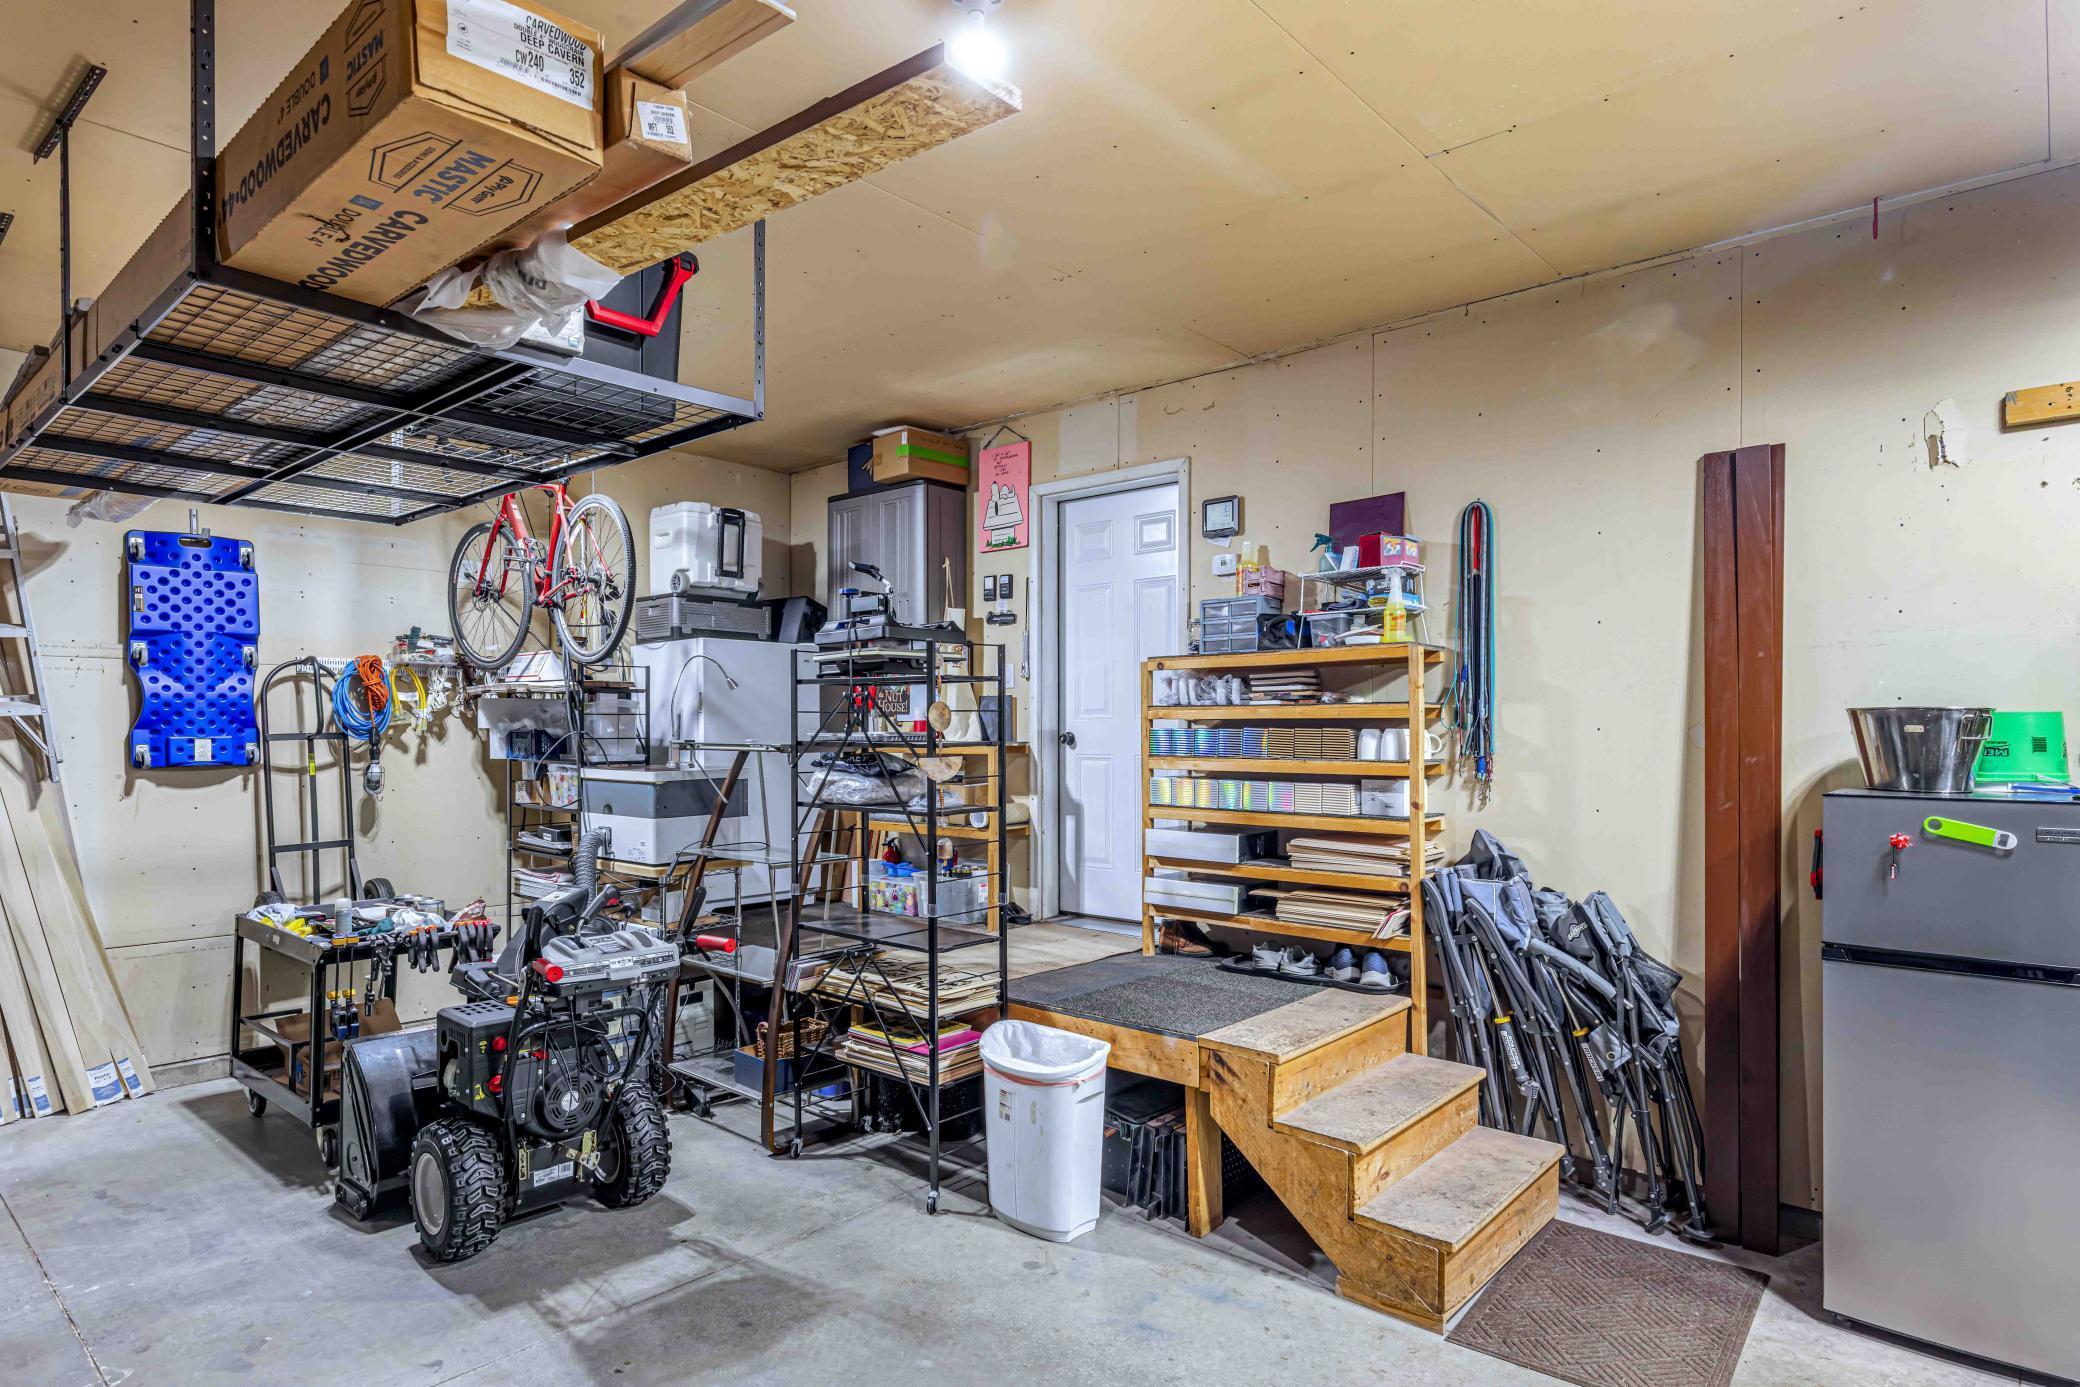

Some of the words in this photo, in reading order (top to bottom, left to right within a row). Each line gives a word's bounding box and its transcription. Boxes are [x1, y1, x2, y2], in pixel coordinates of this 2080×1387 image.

[520, 32, 545, 49] DEEP
[548, 43, 585, 67] CAVERN
[526, 15, 587, 51] CARVEDWOOD
[346, 28, 384, 81] MASTIC
[286, 71, 315, 115] DOUBLE
[569, 68, 585, 89] 352
[413, 150, 496, 204] MASTIC
[298, 210, 429, 290] CARVEDWOOD
[878, 700, 908, 713] HOUSE!
[885, 689, 903, 703] NUT
[1583, 1046, 1602, 1078] ROCKER
